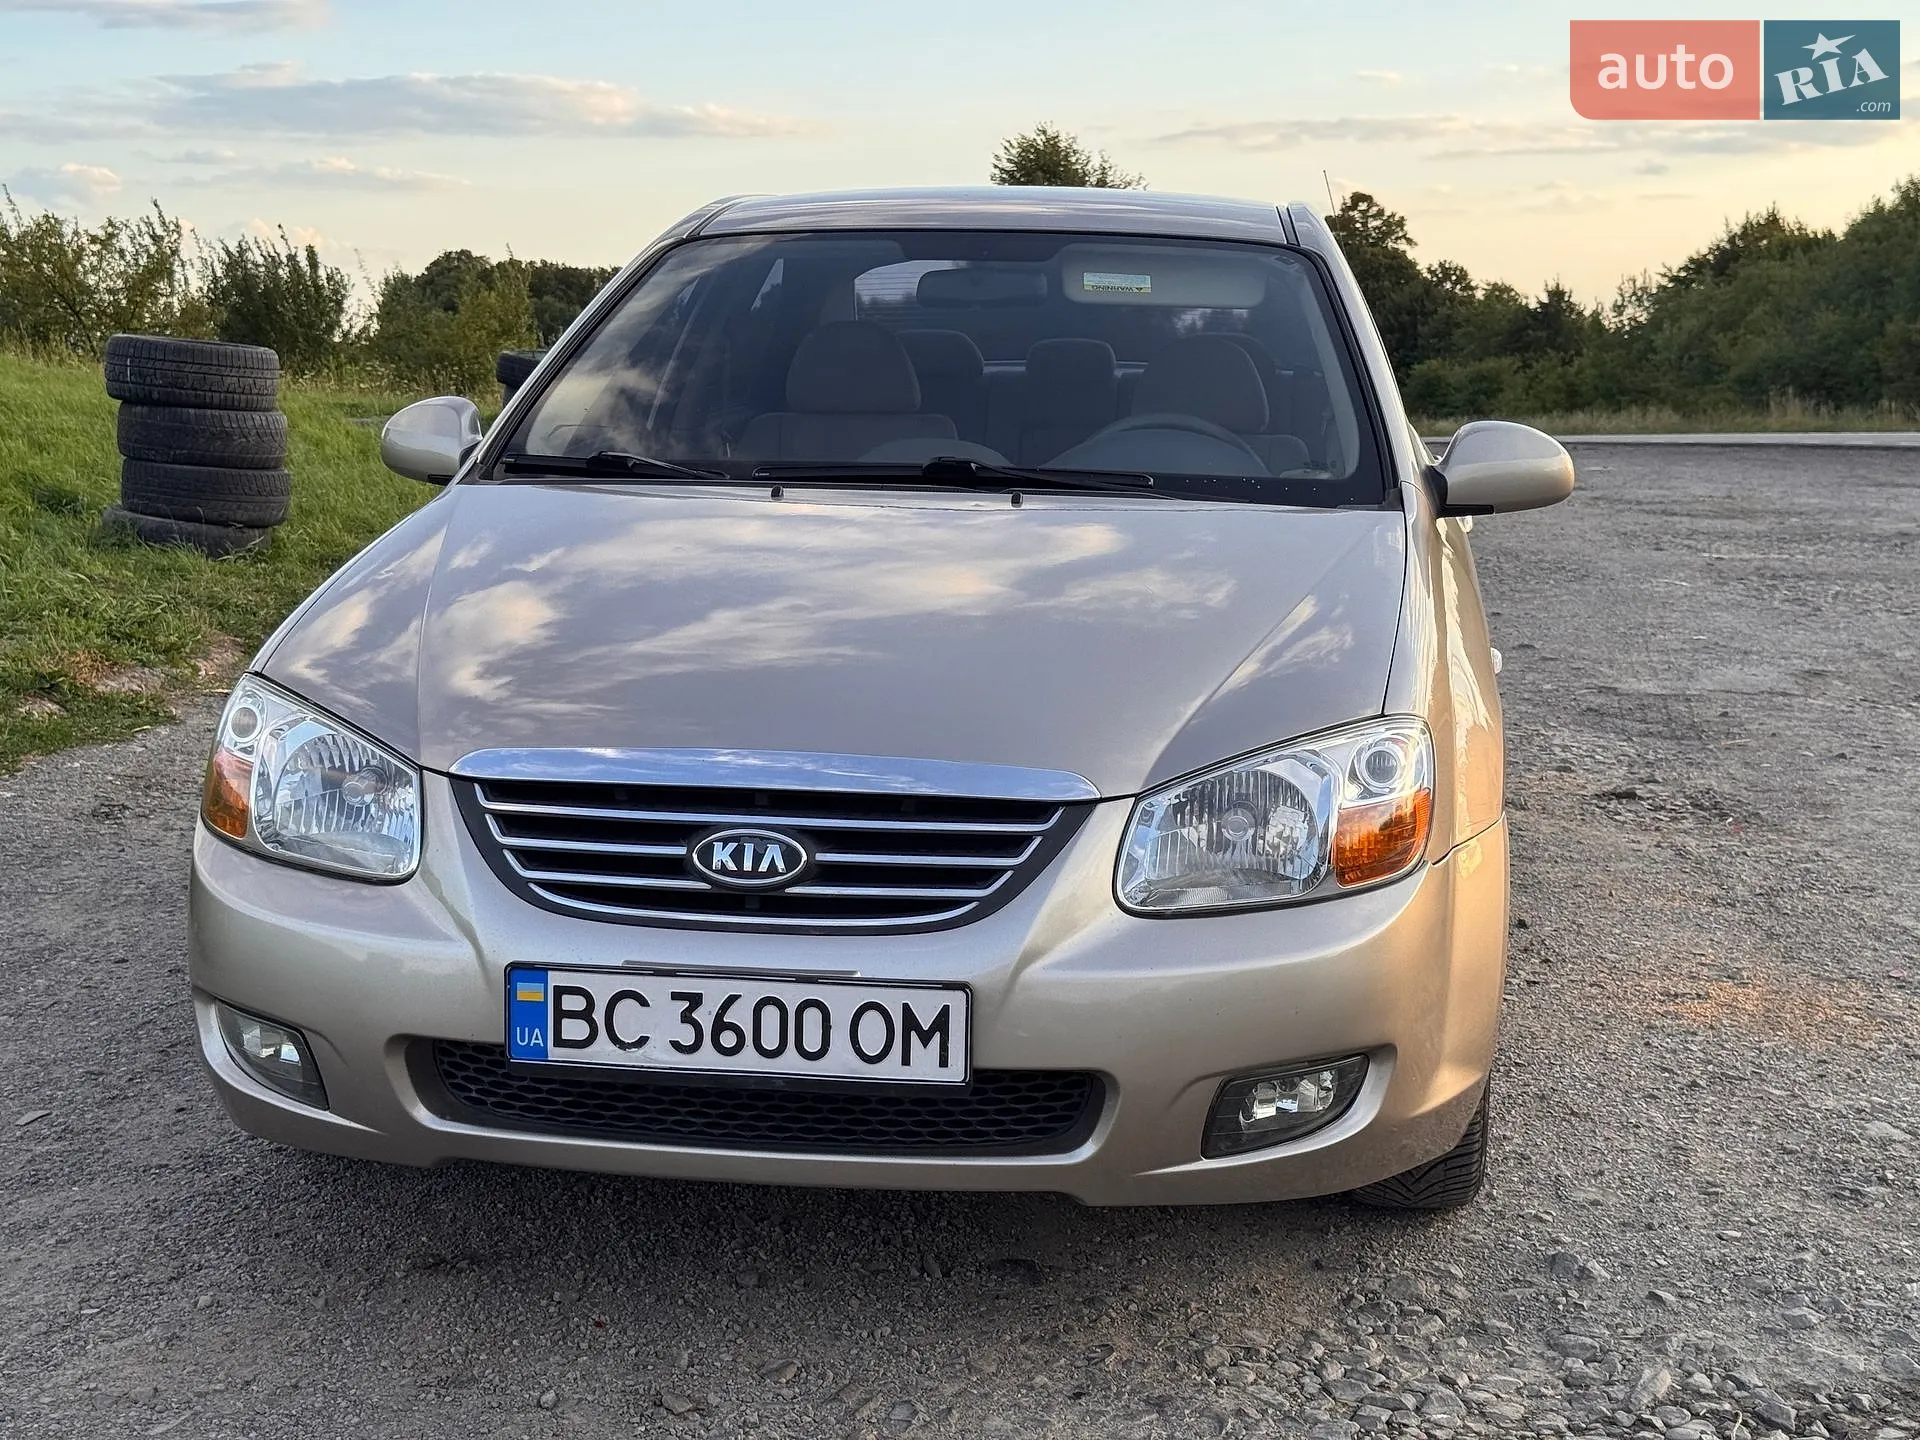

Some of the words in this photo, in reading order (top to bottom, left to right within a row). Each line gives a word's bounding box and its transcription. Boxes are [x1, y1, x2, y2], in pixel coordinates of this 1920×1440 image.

[1091, 284, 1134, 293] WARNING
[712, 841, 787, 873] KIA
[516, 1026, 544, 1048] UA
[553, 984, 651, 1051] BC
[669, 991, 832, 1061] 3600
[849, 1000, 951, 1068] OM
